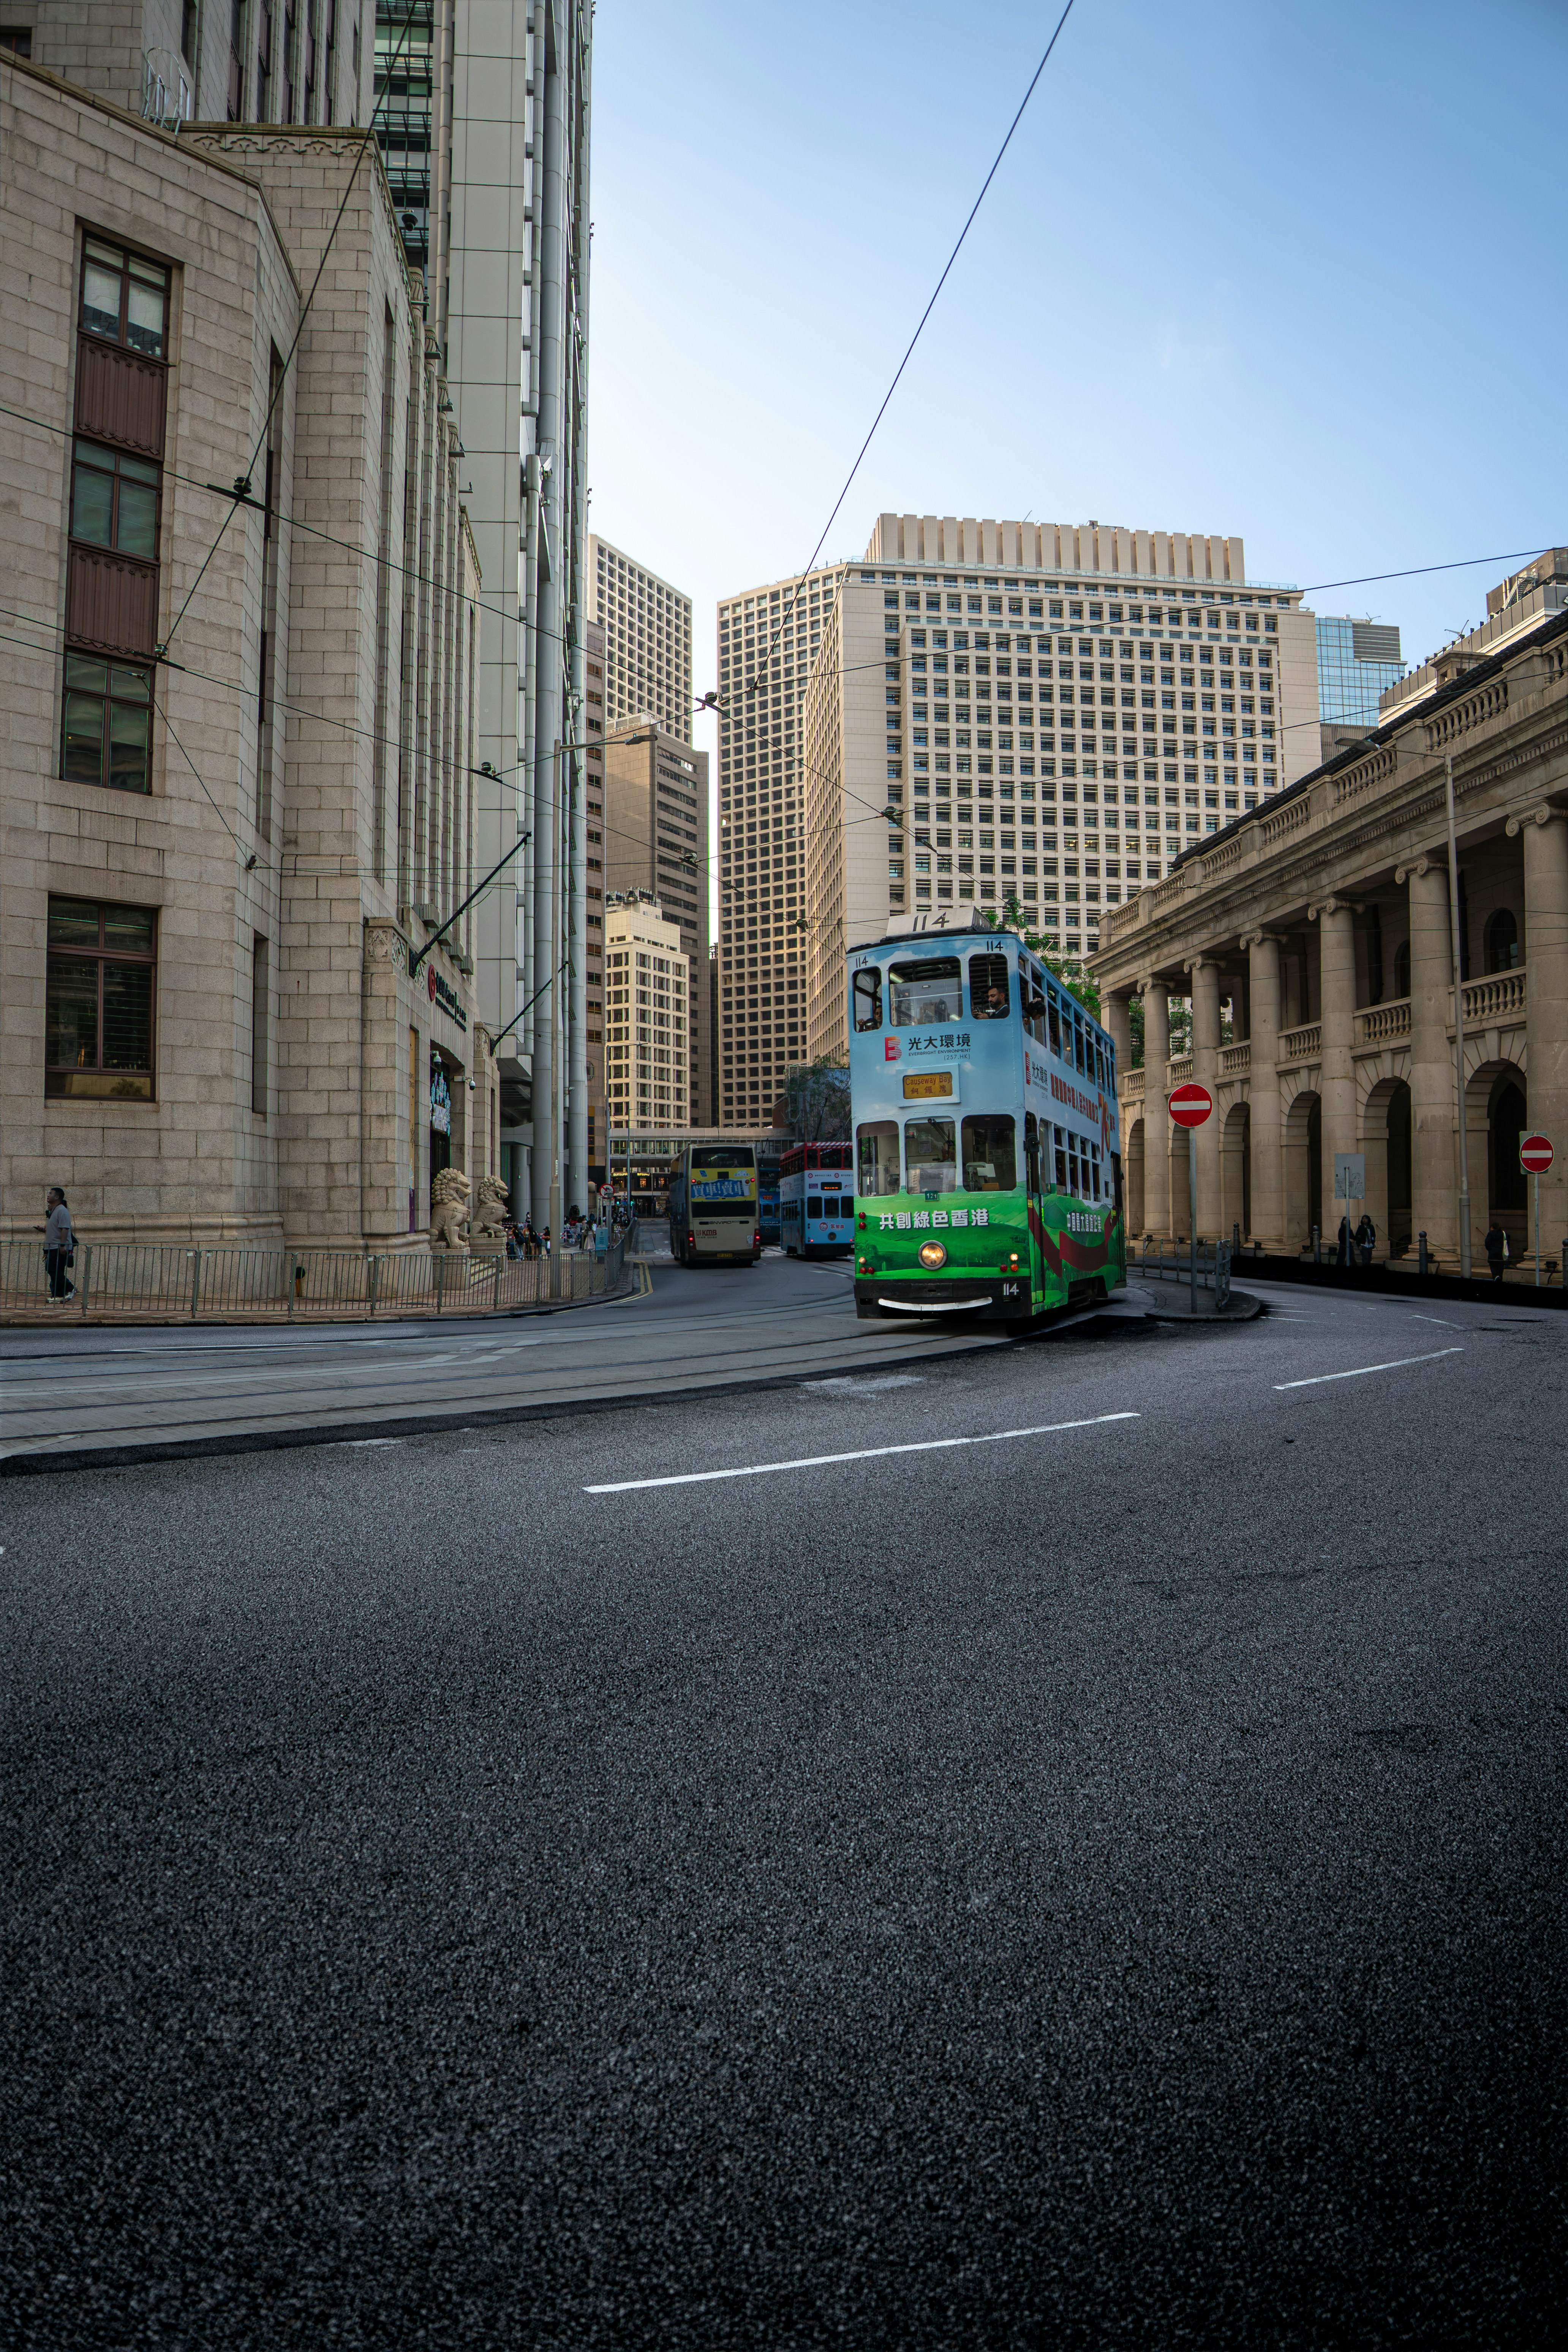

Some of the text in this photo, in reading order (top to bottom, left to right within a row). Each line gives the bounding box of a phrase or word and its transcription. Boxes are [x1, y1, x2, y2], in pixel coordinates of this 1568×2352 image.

[913, 912, 950, 932] 114
[986, 940, 1004, 952] 114
[856, 955, 869, 968] 114
[909, 1033, 971, 1051] 光大環境
[906, 1075, 951, 1086] Causeway Bay
[1032, 1061, 1048, 1086] 光大環境
[911, 1085, 947, 1094] 銅鑼灣
[1098, 1091, 1110, 1162] 76
[880, 1208, 989, 1230] 共創綠色香港
[1003, 1283, 1019, 1295] 114
